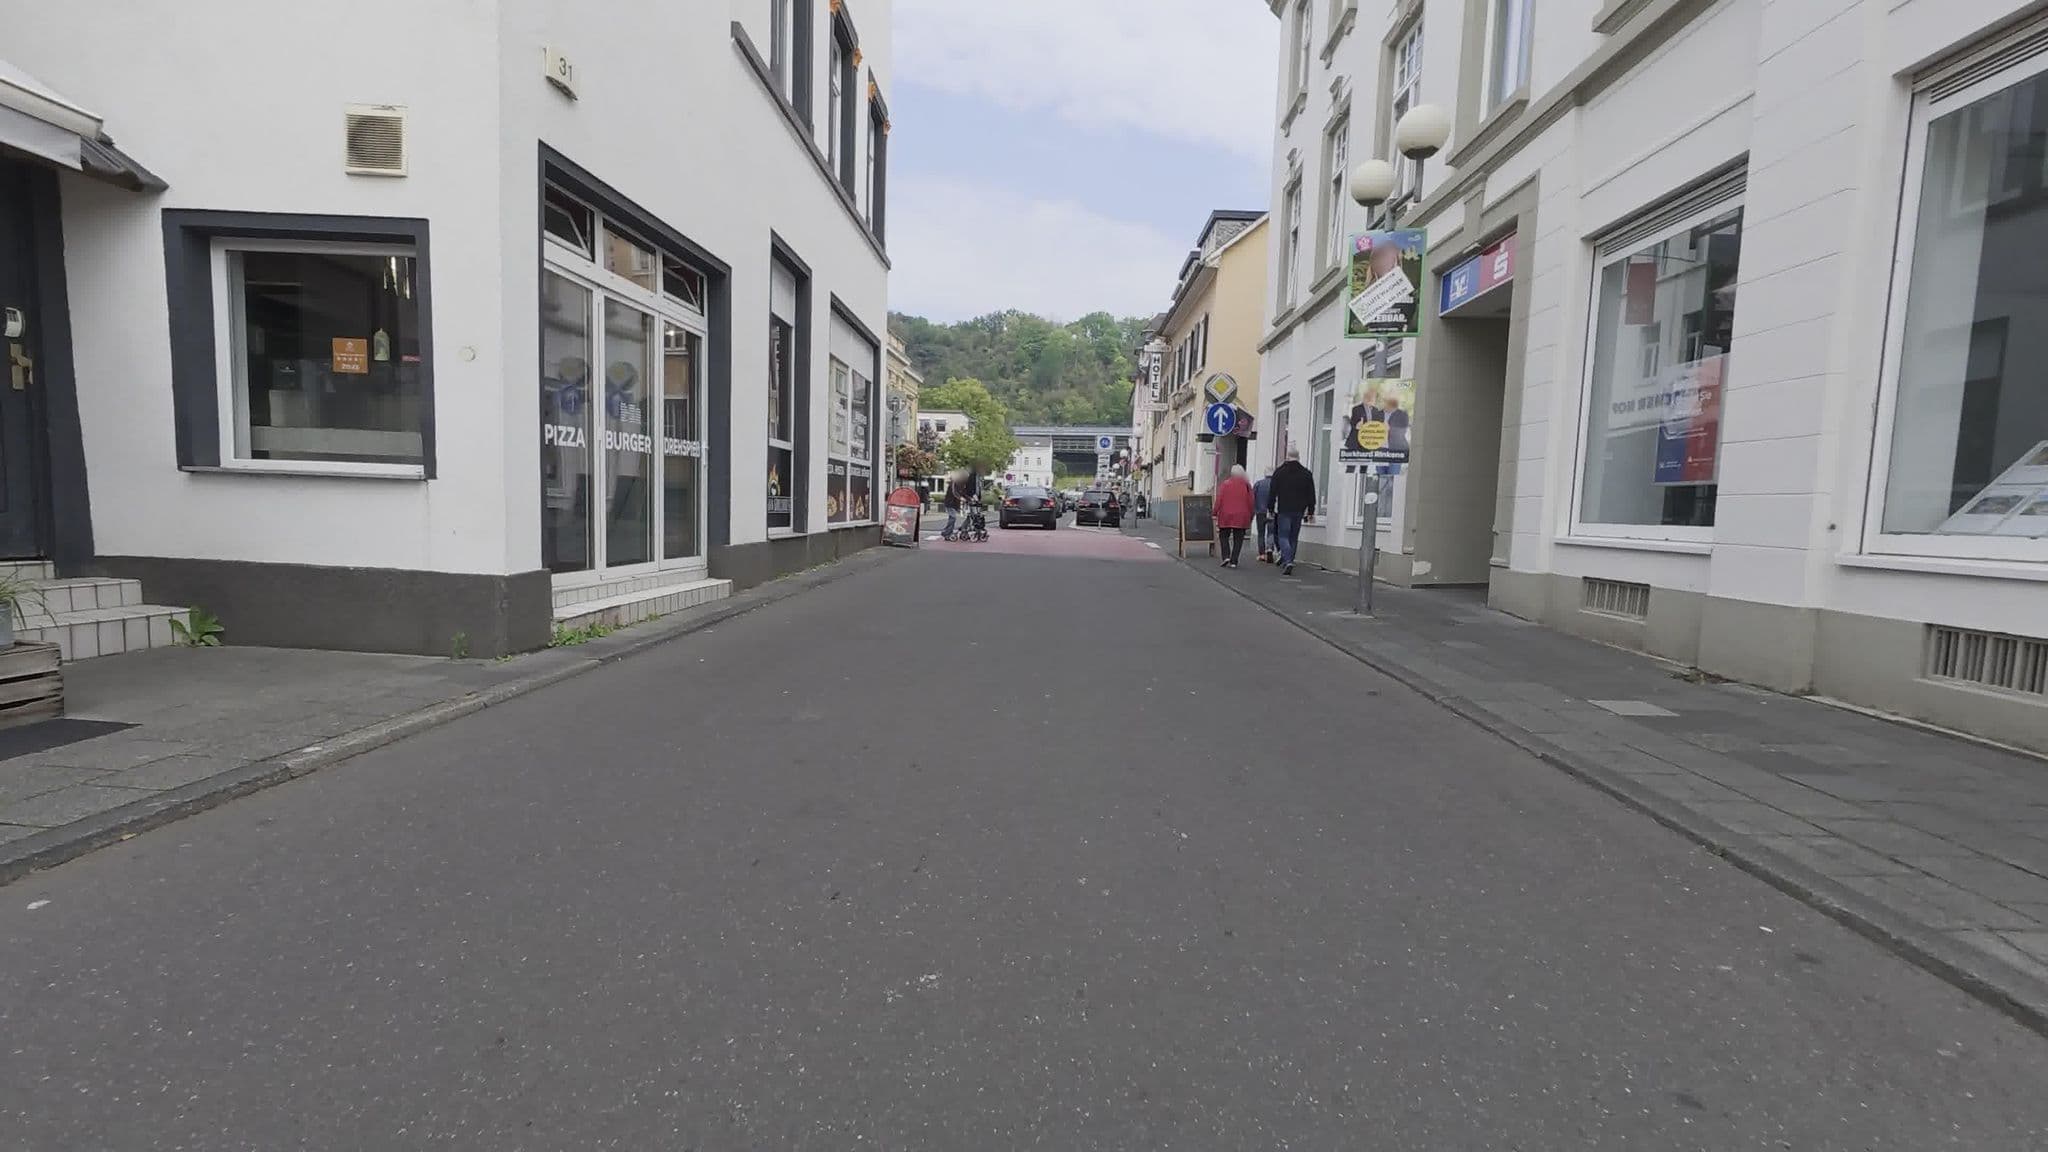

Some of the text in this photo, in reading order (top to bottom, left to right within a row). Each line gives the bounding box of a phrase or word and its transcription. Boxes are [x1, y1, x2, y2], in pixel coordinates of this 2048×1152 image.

[559, 57, 572, 82] 31
[1152, 356, 1160, 398] HOTEL
[544, 423, 586, 448] PIZZA
[605, 430, 652, 454] BURGER
